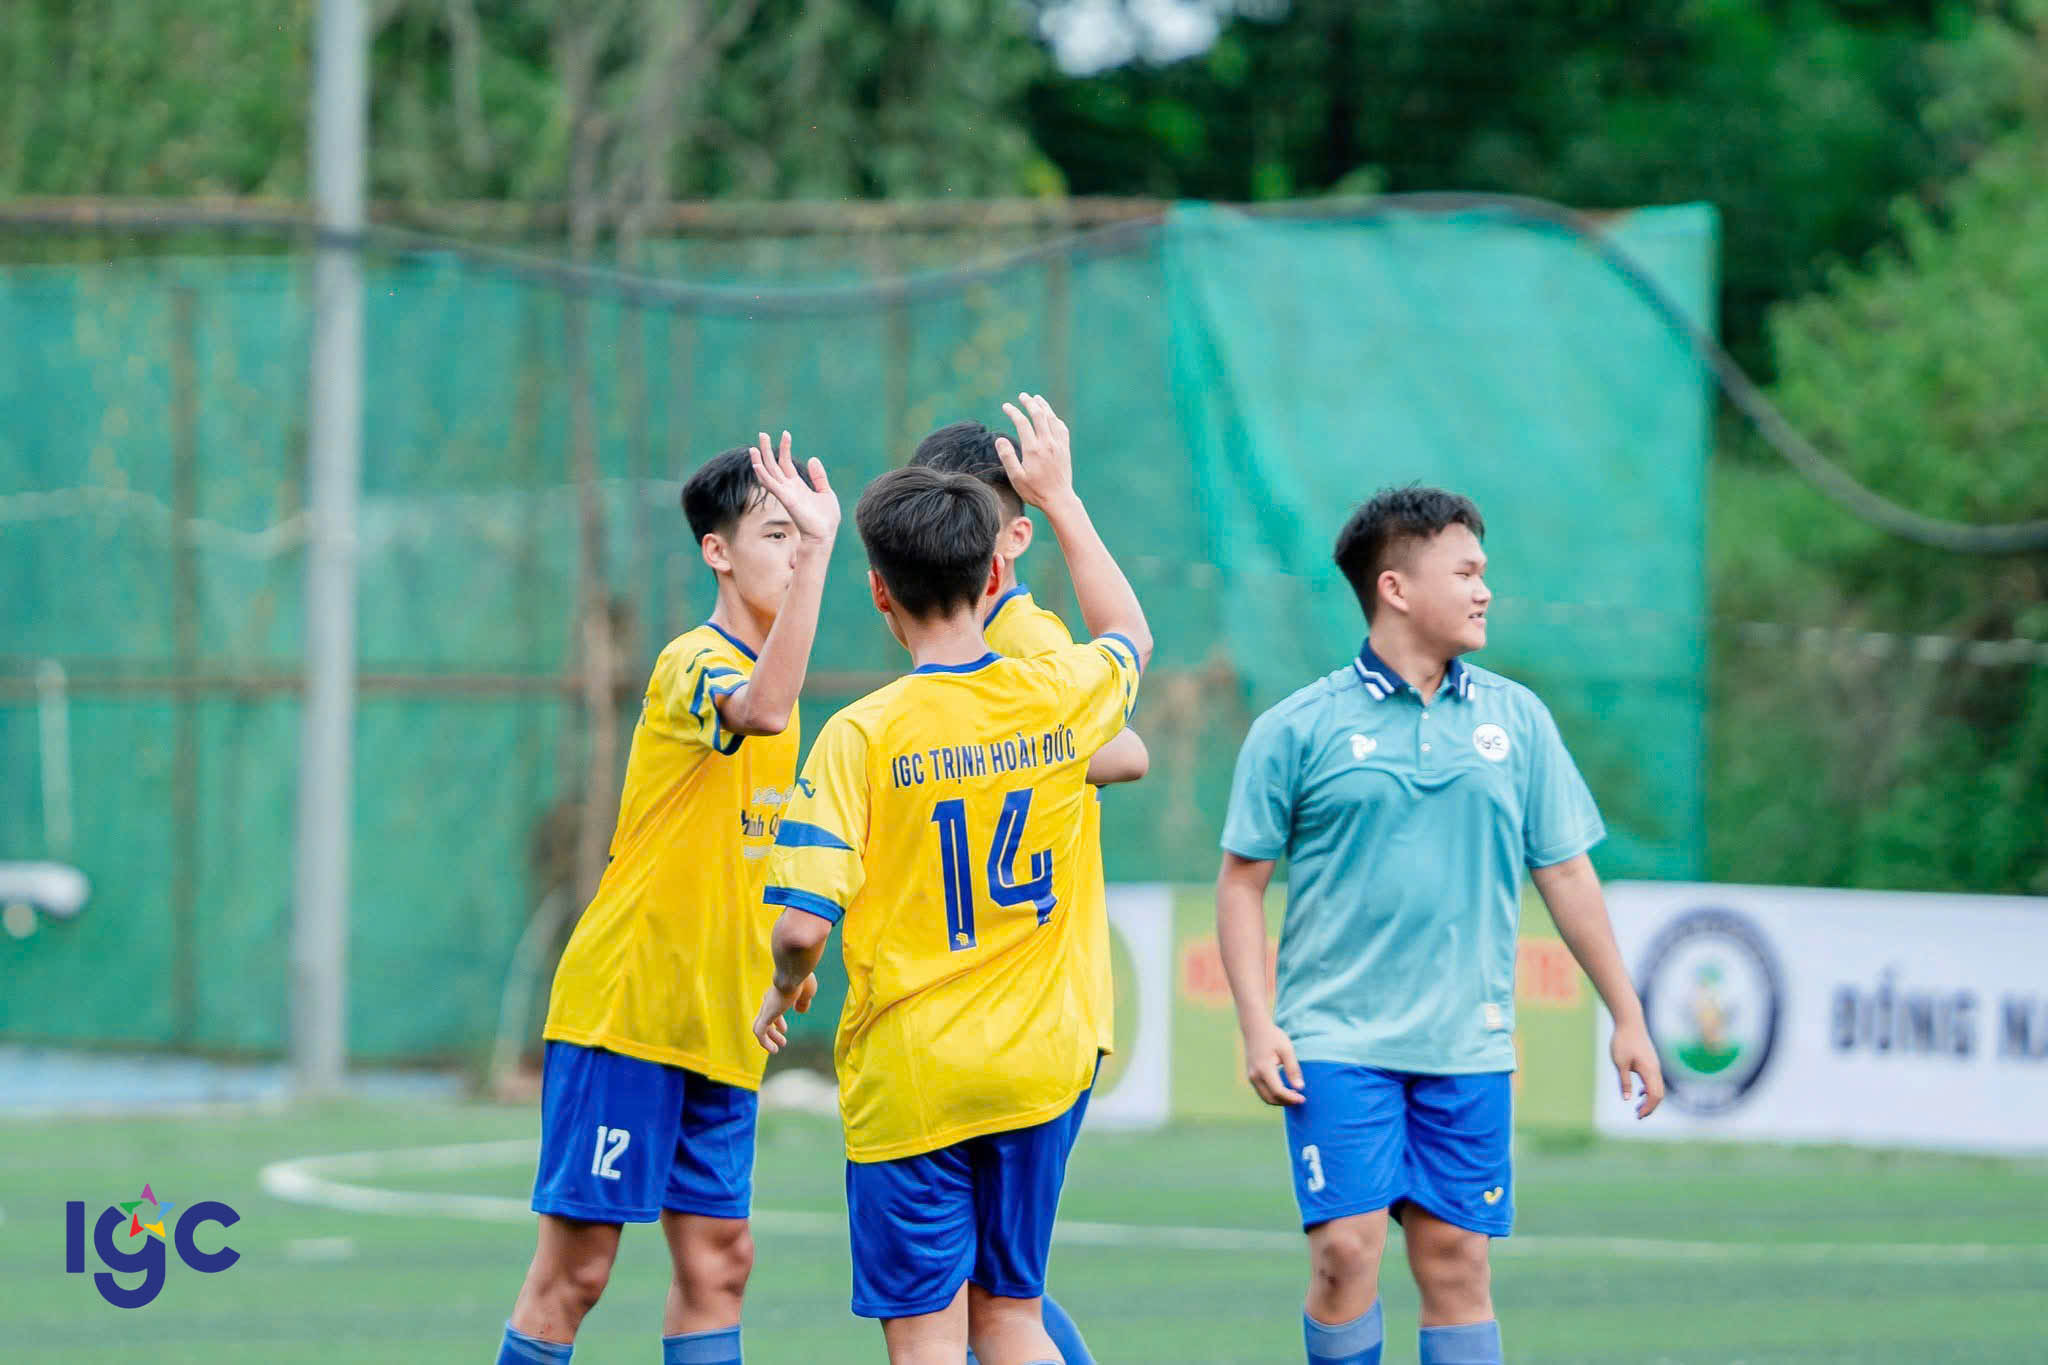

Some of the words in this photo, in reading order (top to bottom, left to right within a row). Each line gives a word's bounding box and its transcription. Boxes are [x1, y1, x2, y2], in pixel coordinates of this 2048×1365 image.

[892, 754, 925, 789] IGC
[930, 743, 988, 785] TRỊNH
[992, 731, 1038, 774] HOÀI
[1043, 724, 1077, 765] ĐỨC
[931, 787, 1057, 951] 14
[591, 1125, 631, 1180] 12
[1302, 1144, 1326, 1192] 3
